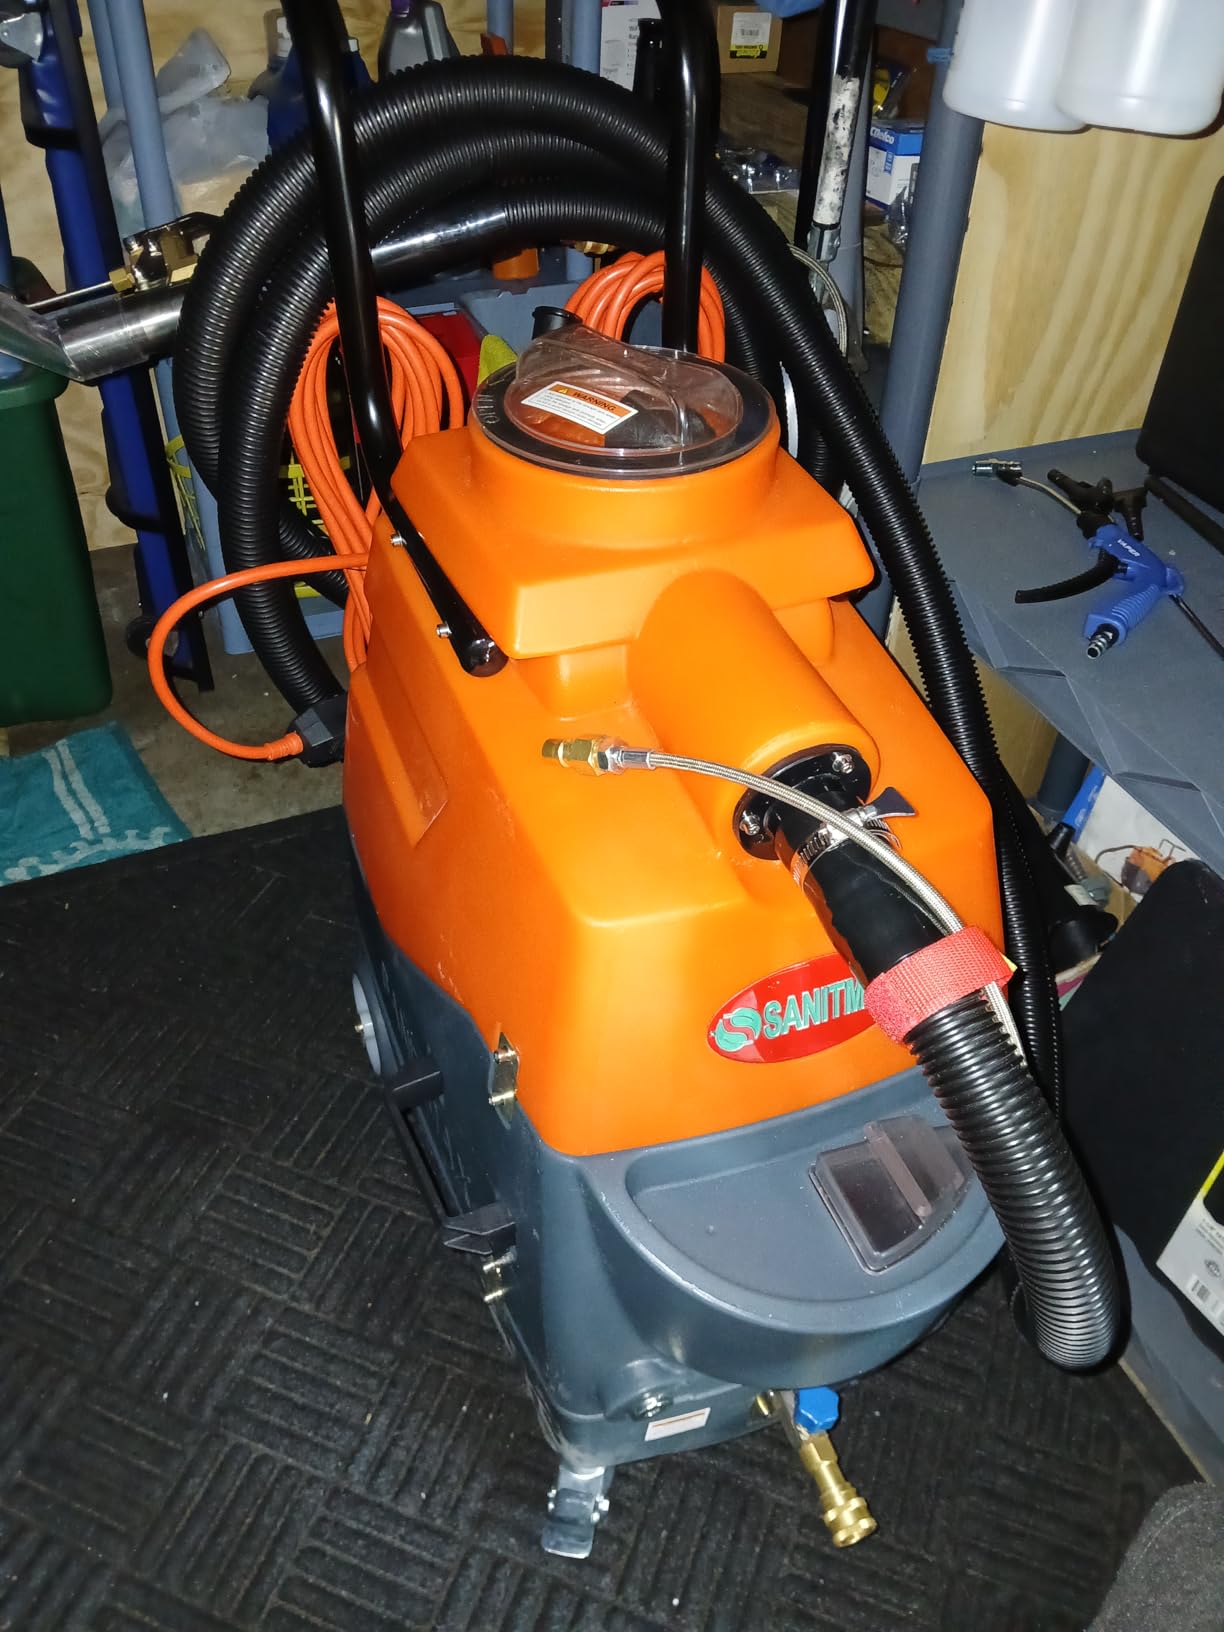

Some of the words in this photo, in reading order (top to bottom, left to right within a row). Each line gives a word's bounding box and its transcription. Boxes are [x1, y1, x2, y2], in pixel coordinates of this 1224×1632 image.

[573, 390, 617, 412] WARNING
[1117, 539, 1140, 557] VAPER
[763, 977, 865, 1040] SANITM
